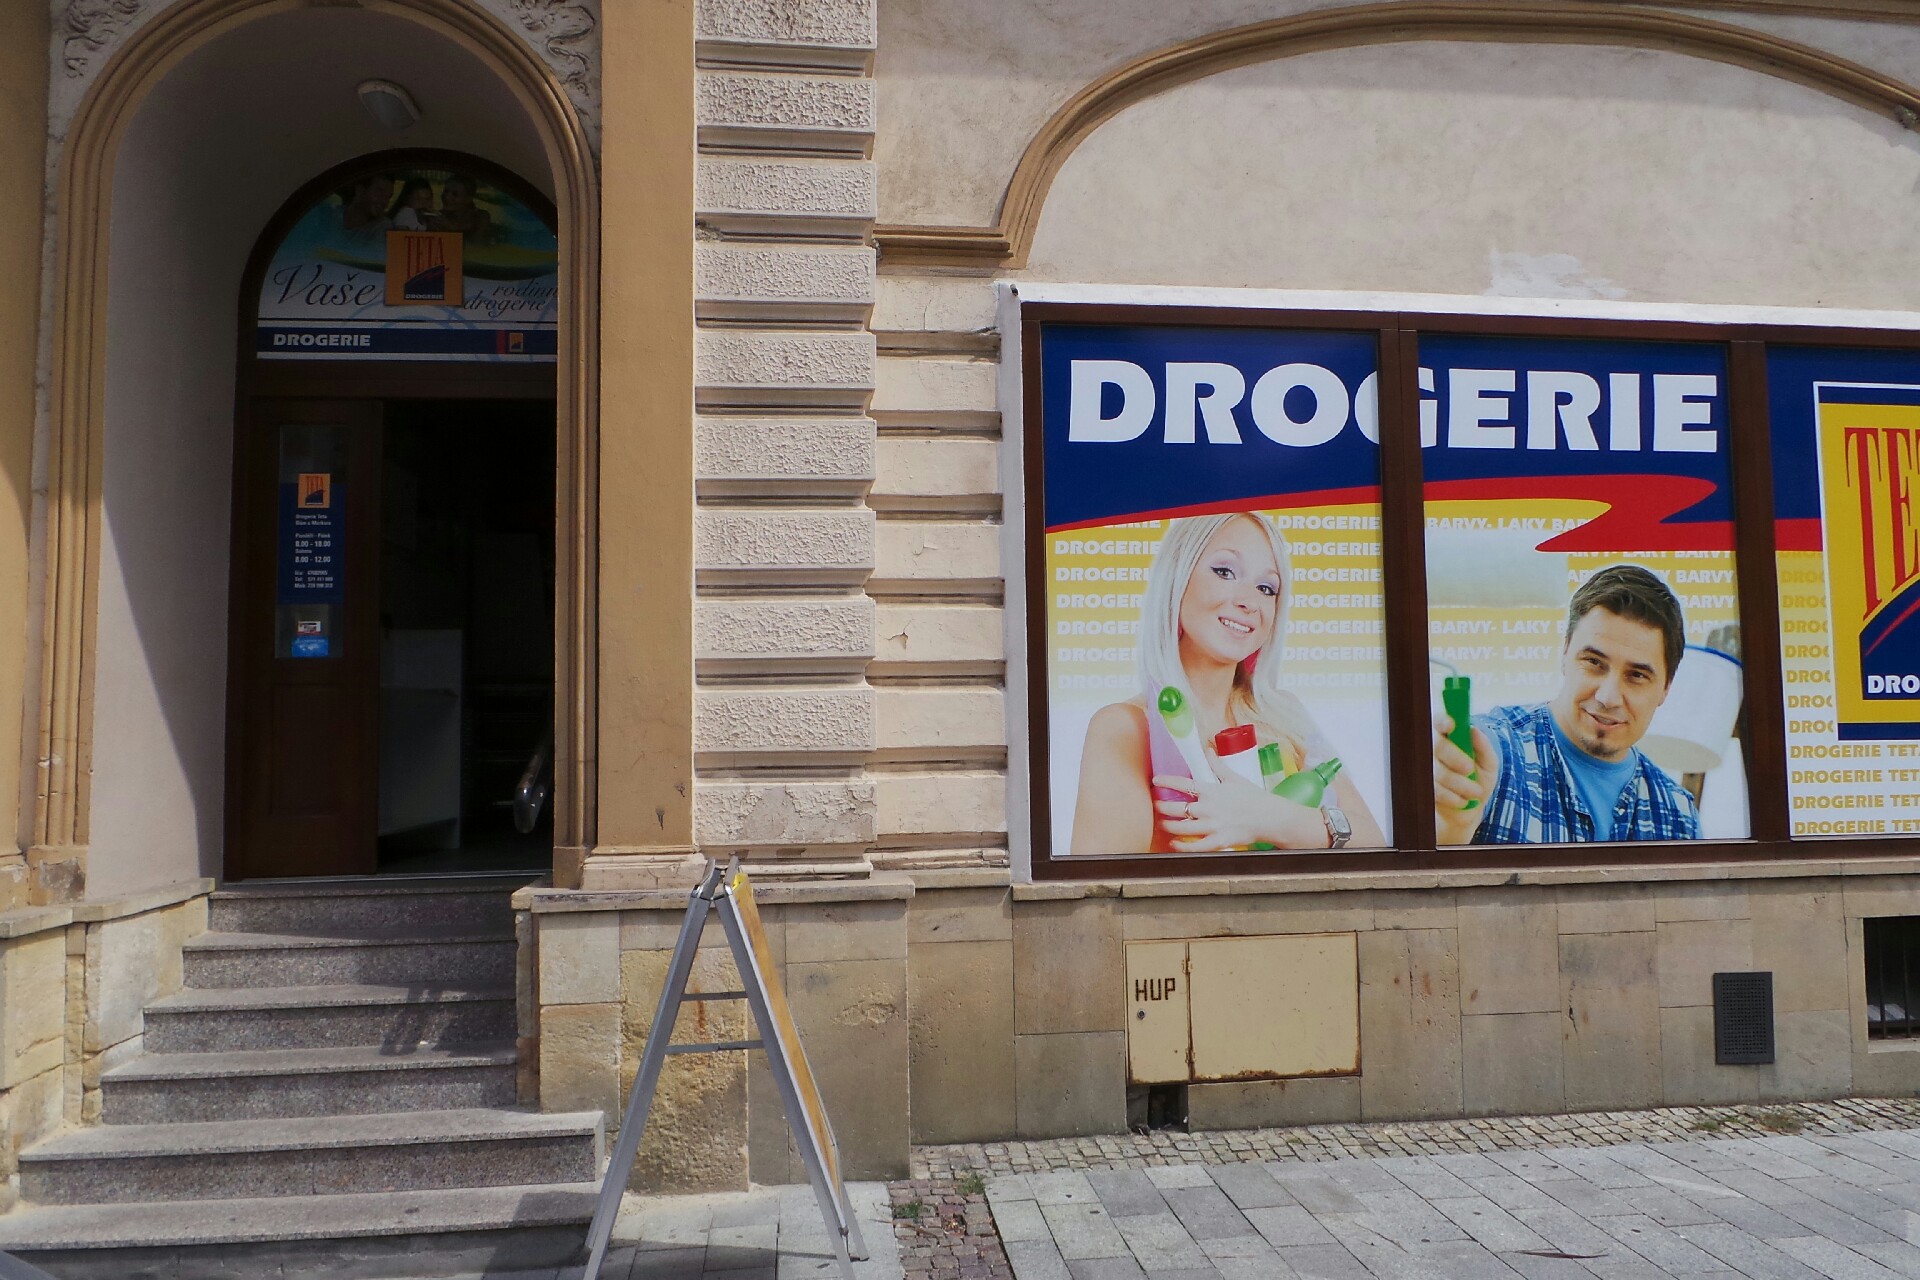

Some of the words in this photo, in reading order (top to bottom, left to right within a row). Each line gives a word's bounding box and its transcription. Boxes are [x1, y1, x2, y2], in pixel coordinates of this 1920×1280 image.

[404, 236, 444, 281] TETA
[273, 264, 384, 306] Vaše
[464, 290, 547, 318] drogerie
[273, 334, 371, 347] DROGERIE
[1278, 516, 1380, 530] DROGERIE
[1498, 518, 1546, 531] LAKY
[1845, 427, 1920, 621] TE
[1676, 570, 1734, 583] BARVY
[1502, 620, 1552, 634] LAKY
[1504, 646, 1553, 660] LAKY
[1790, 744, 1881, 758] DROGERIE
[1792, 769, 1883, 783] DROGERIE
[1793, 795, 1884, 809] DROGERIE
[1794, 820, 1885, 834] DROGERIE
[1135, 978, 1175, 1001] HUP
